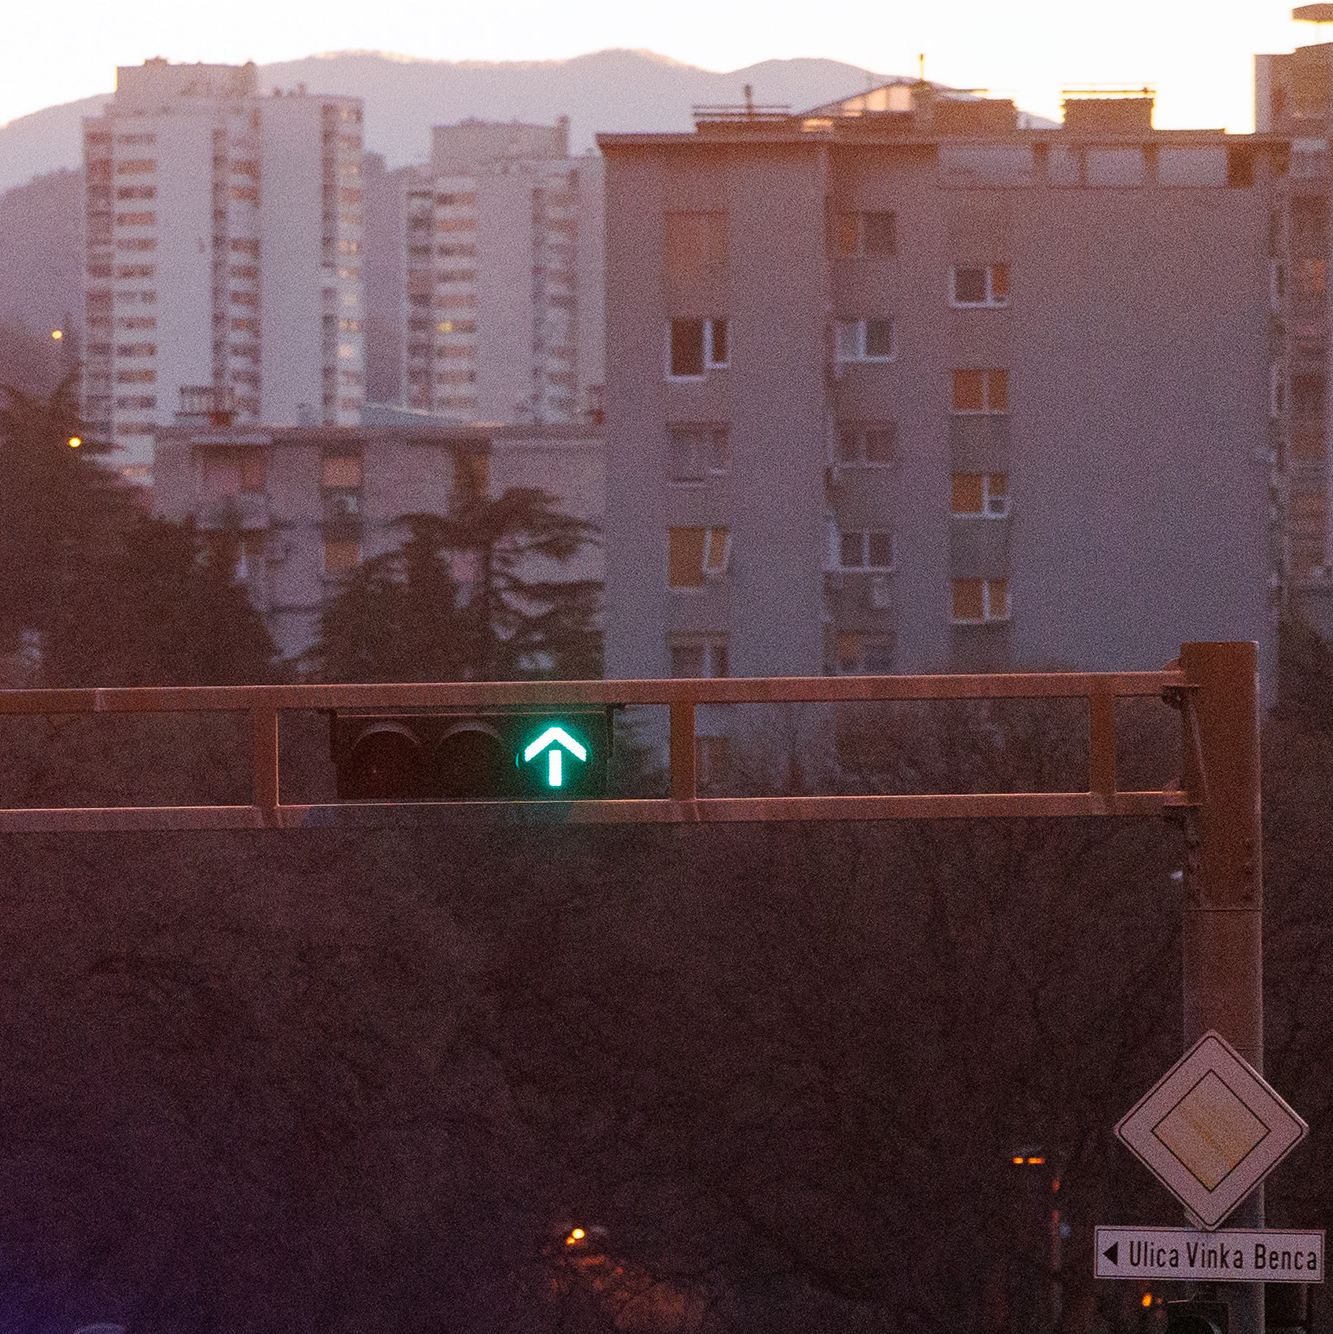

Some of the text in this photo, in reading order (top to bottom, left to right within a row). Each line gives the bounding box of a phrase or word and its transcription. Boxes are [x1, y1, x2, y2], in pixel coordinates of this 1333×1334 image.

[1129, 1240, 1317, 1271] Ulica Vinka Benca
